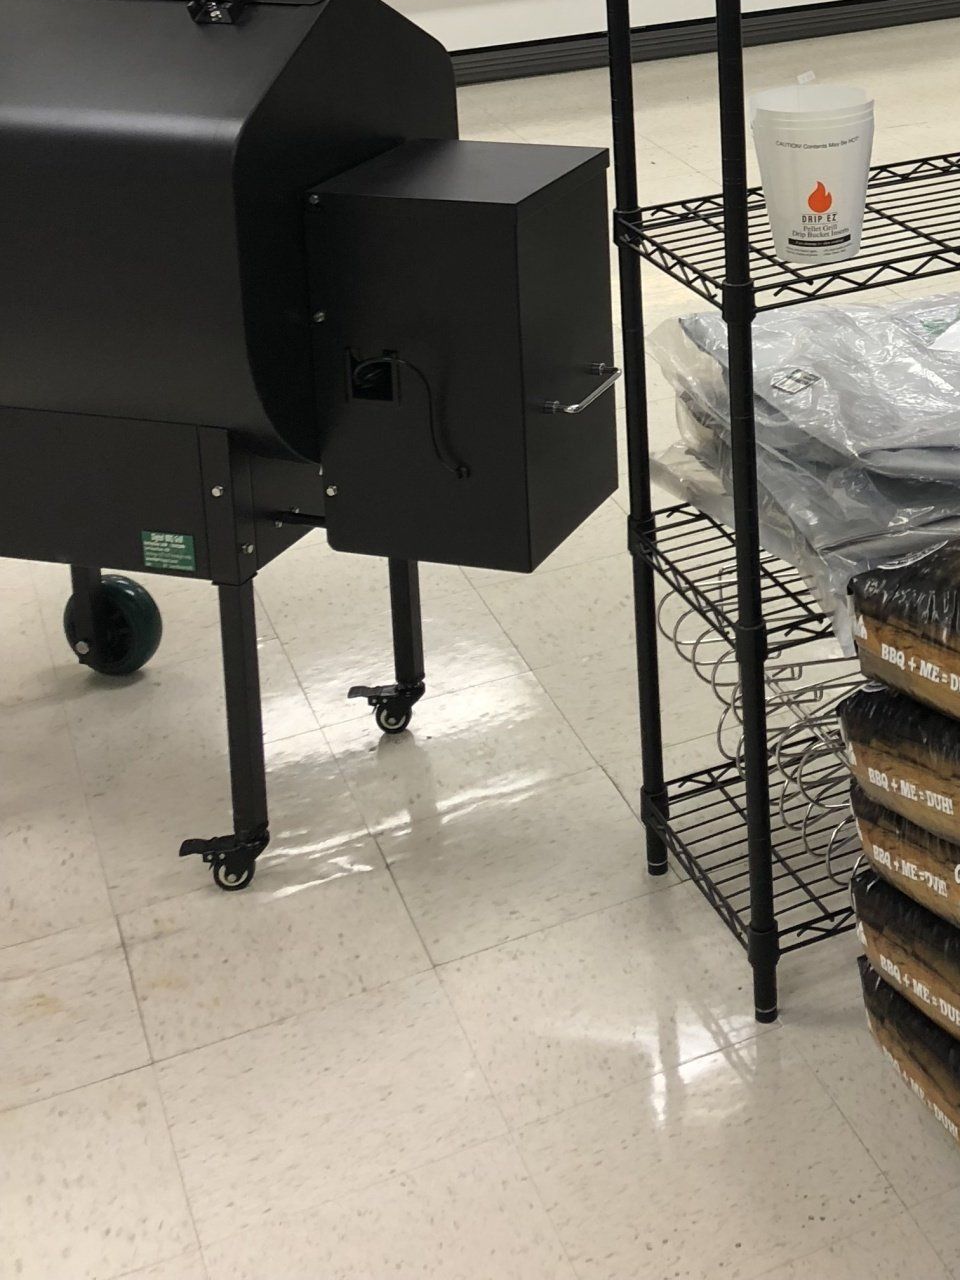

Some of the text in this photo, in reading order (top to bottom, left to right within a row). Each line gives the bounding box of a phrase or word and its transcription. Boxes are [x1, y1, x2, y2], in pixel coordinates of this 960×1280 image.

[827, 214, 836, 222] EZ
[881, 644, 904, 670] BBQ
[920, 660, 940, 683] ME
